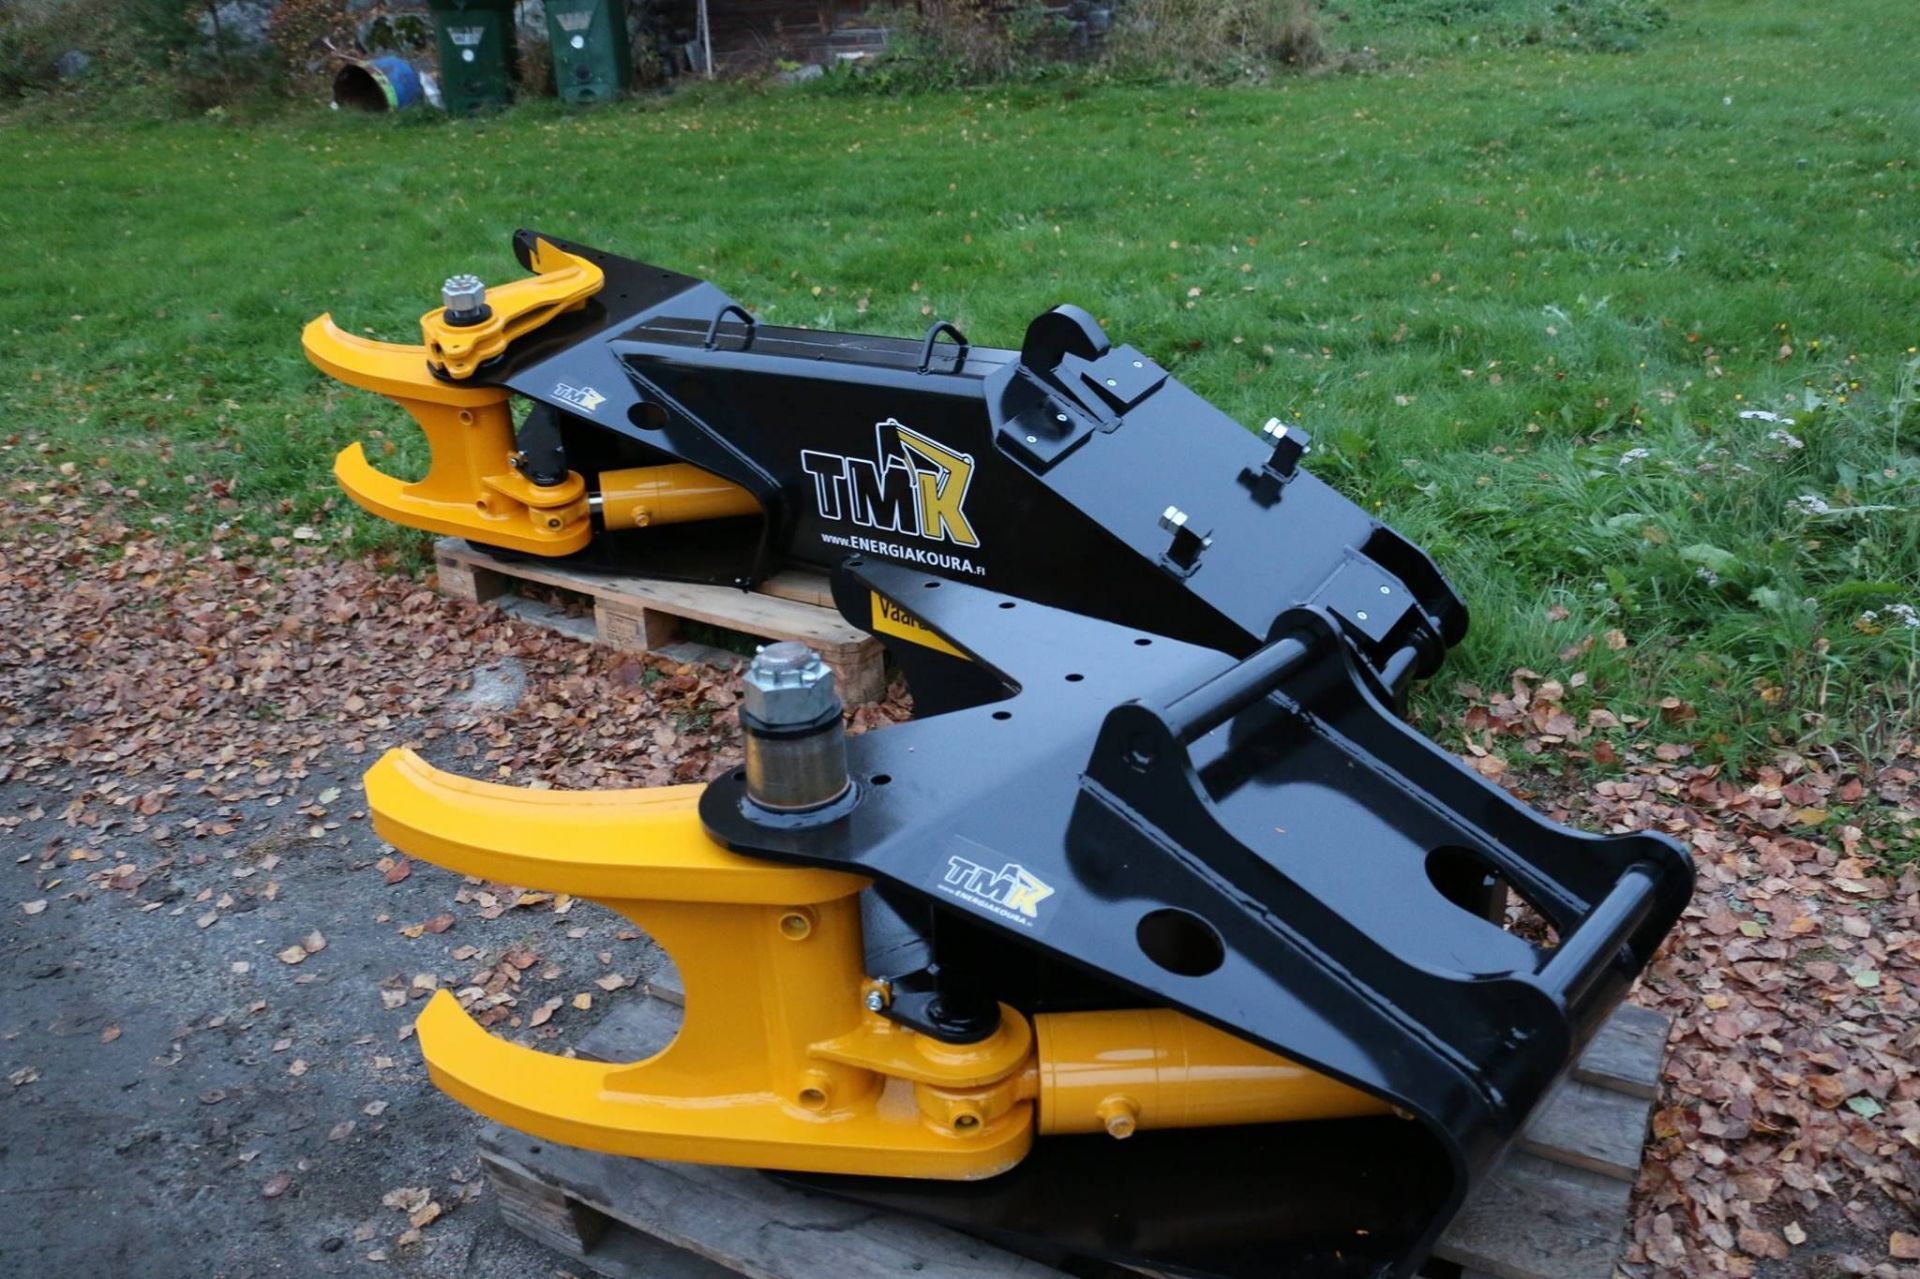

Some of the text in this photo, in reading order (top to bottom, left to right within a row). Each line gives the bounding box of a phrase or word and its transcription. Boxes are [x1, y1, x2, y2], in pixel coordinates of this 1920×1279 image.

[553, 382, 607, 411] TMK
[801, 418, 980, 548] TMK
[821, 533, 986, 576] www.ENERGIAKOURA.FI
[944, 855, 1055, 918] TMK
